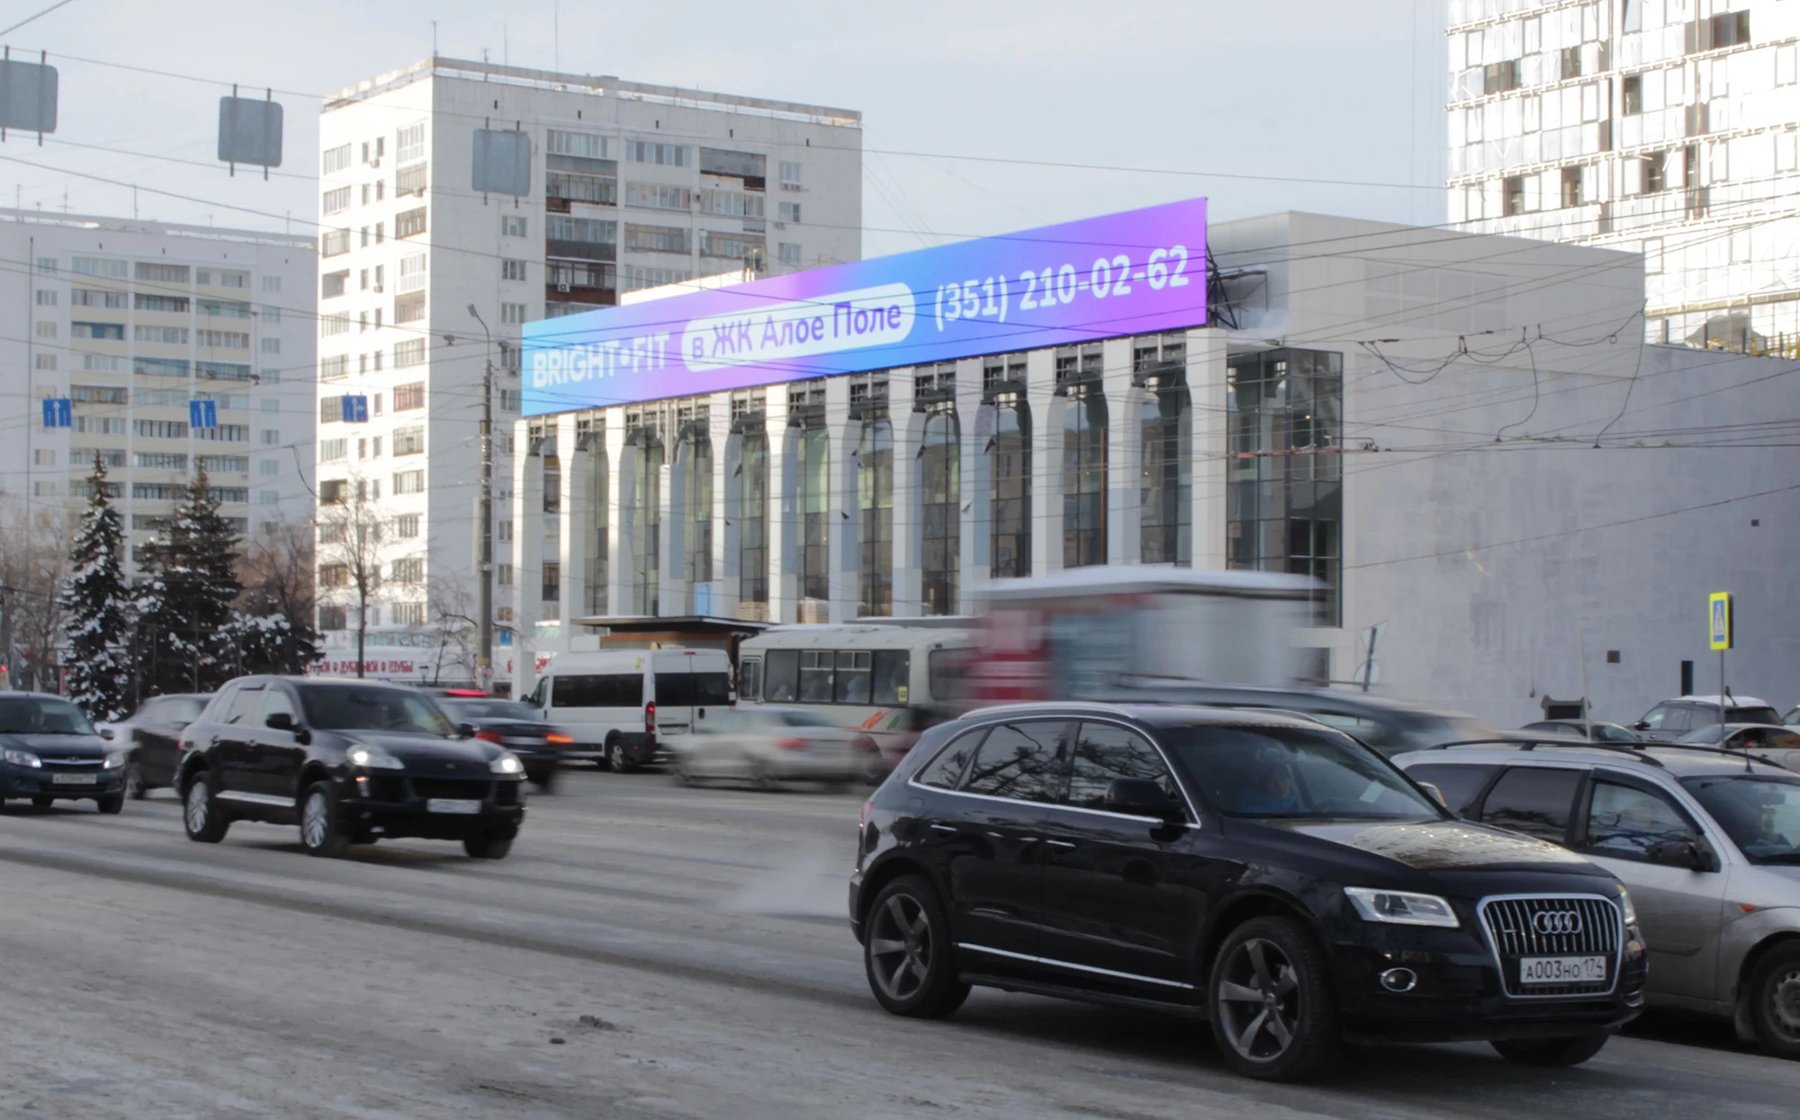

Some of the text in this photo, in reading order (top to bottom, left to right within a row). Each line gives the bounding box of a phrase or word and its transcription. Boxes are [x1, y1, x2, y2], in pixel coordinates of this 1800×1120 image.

[711, 317, 753, 358] ЖК
[760, 313, 825, 350] Алое
[833, 300, 902, 339] Поле
[934, 275, 1009, 332] (351)
[1018, 244, 1190, 312] 210-02-62
